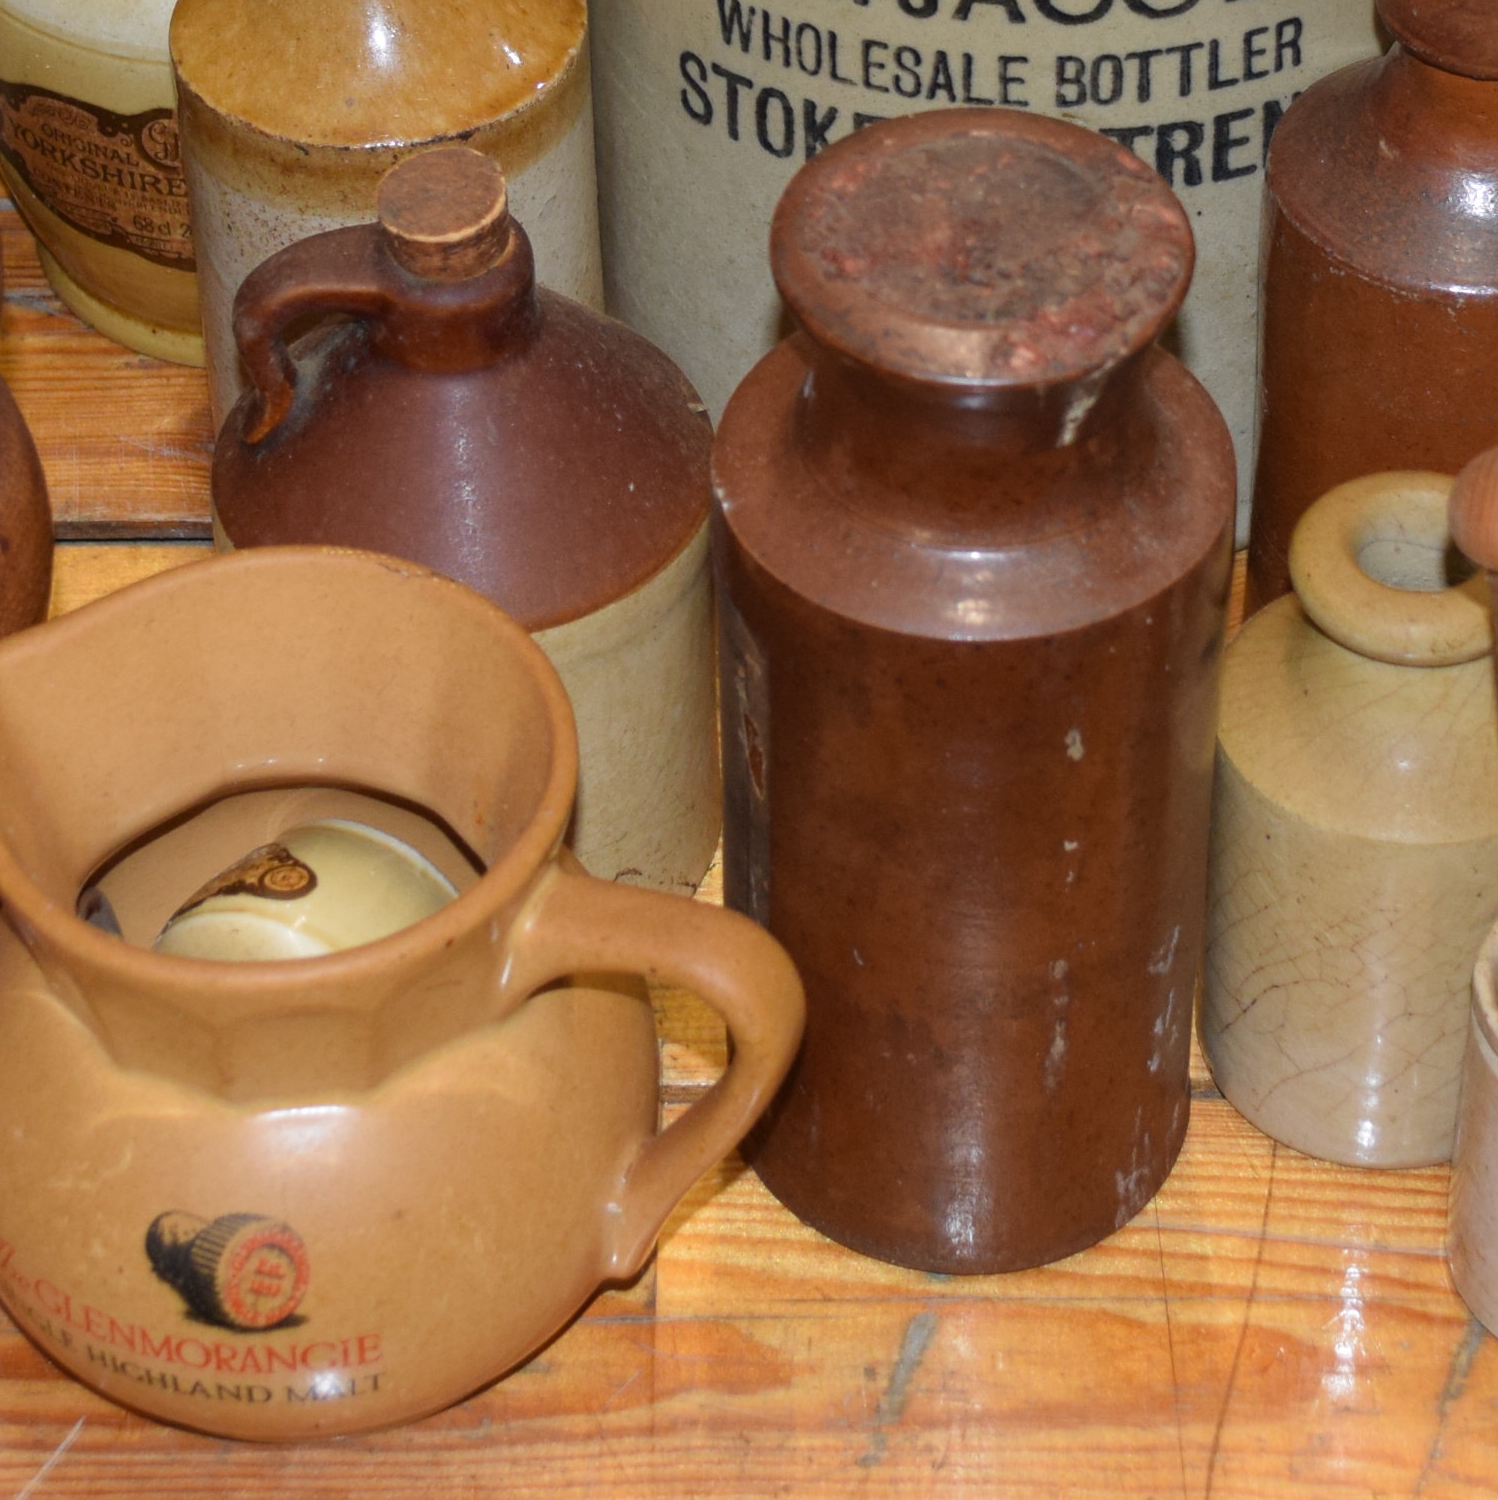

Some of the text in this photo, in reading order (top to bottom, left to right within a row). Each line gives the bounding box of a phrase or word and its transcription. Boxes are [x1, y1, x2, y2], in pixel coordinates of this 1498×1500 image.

[1056, 16, 1303, 108] BOTTLER
[8, 116, 188, 198] YORKSHIRE
[41, 123, 140, 168] ORIGINAL
[133, 214, 155, 233] 68
[35, 1278, 383, 1375] GLENMORANGIE
[87, 1346, 387, 1403] HIGHLAND MALT
